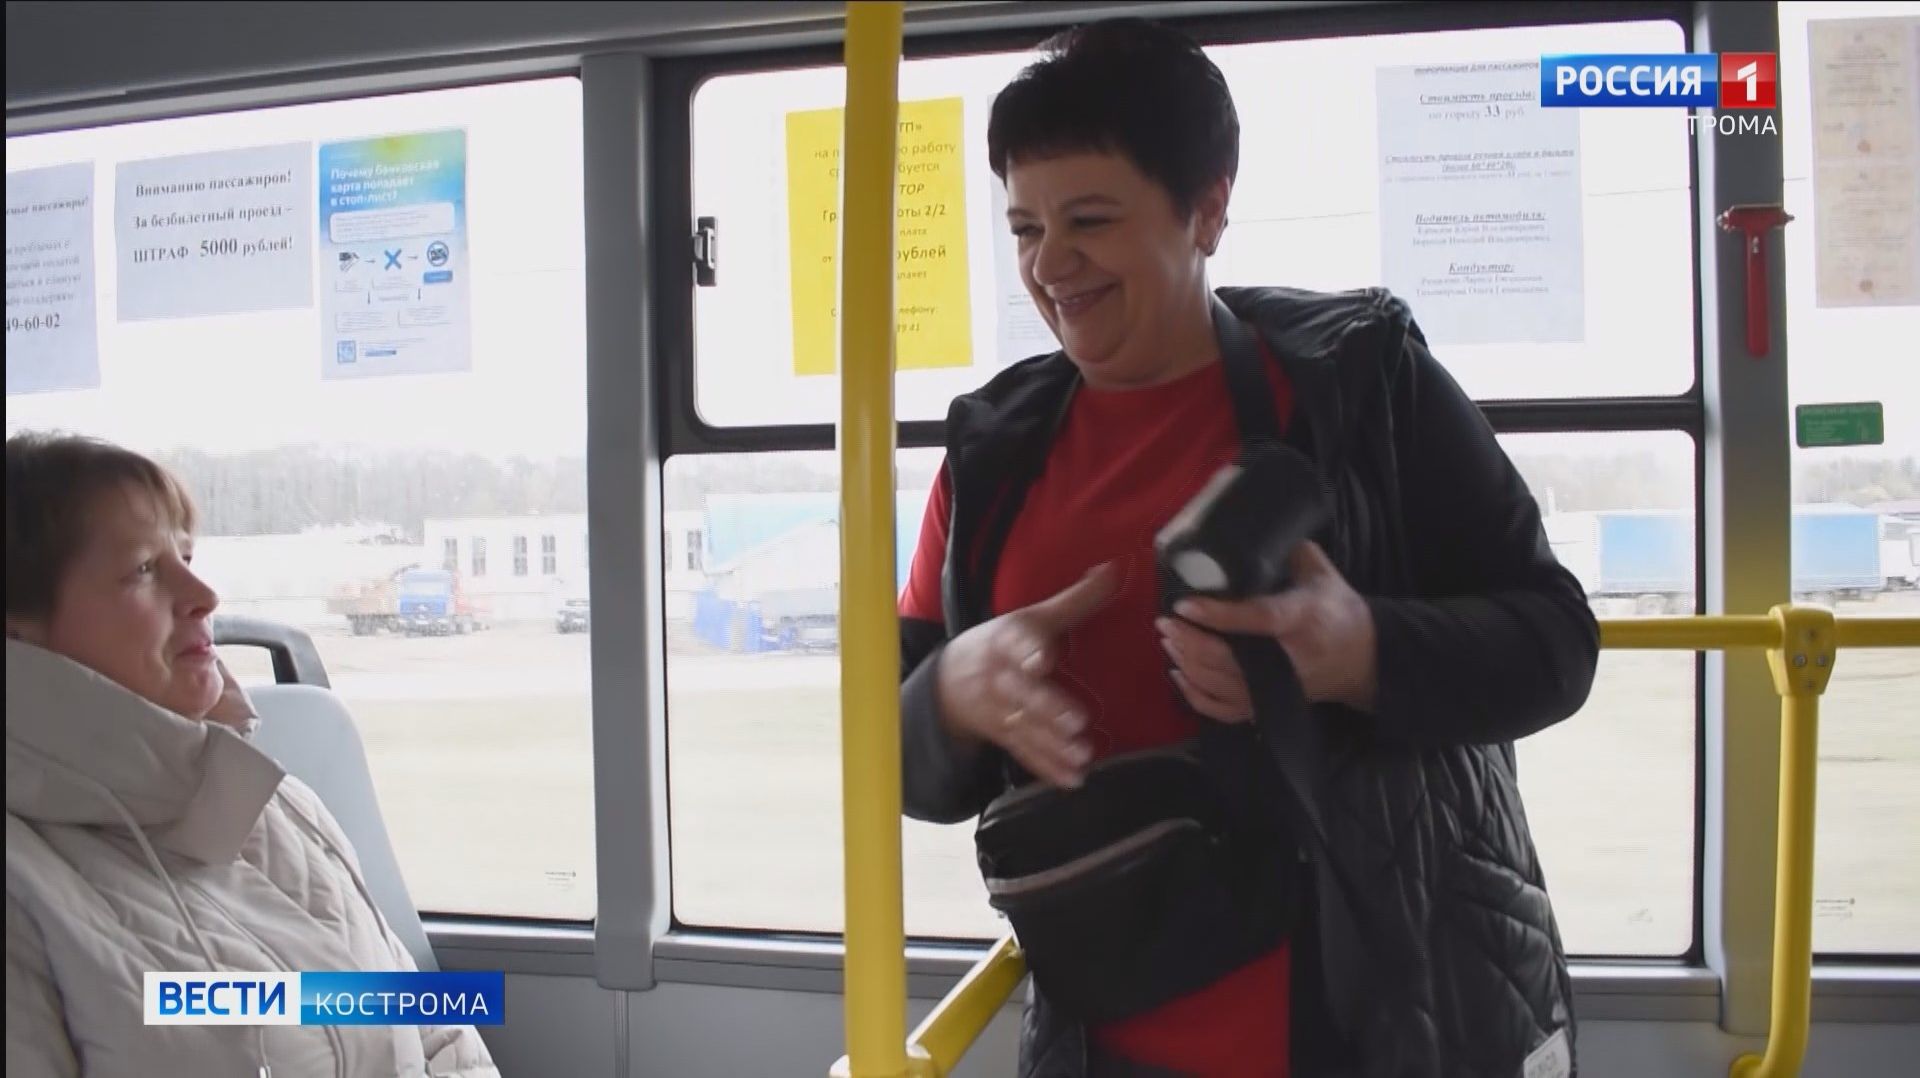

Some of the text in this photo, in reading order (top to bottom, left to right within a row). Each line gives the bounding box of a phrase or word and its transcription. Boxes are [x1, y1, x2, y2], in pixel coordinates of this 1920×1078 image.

[1420, 93, 1485, 105] Стоимость
[1485, 105, 1501, 117] 33
[912, 142, 957, 154] работу
[330, 166, 374, 180] Почему
[897, 162, 940, 174] буется
[135, 169, 292, 197] Вниманию пассажиров!
[331, 183, 361, 195] карта
[924, 204, 946, 217] 2/2
[134, 216, 148, 229] За
[151, 207, 235, 228] безбилетный
[239, 205, 283, 222] проезд
[133, 236, 293, 263] ШТРАФ 5000 рублей!
